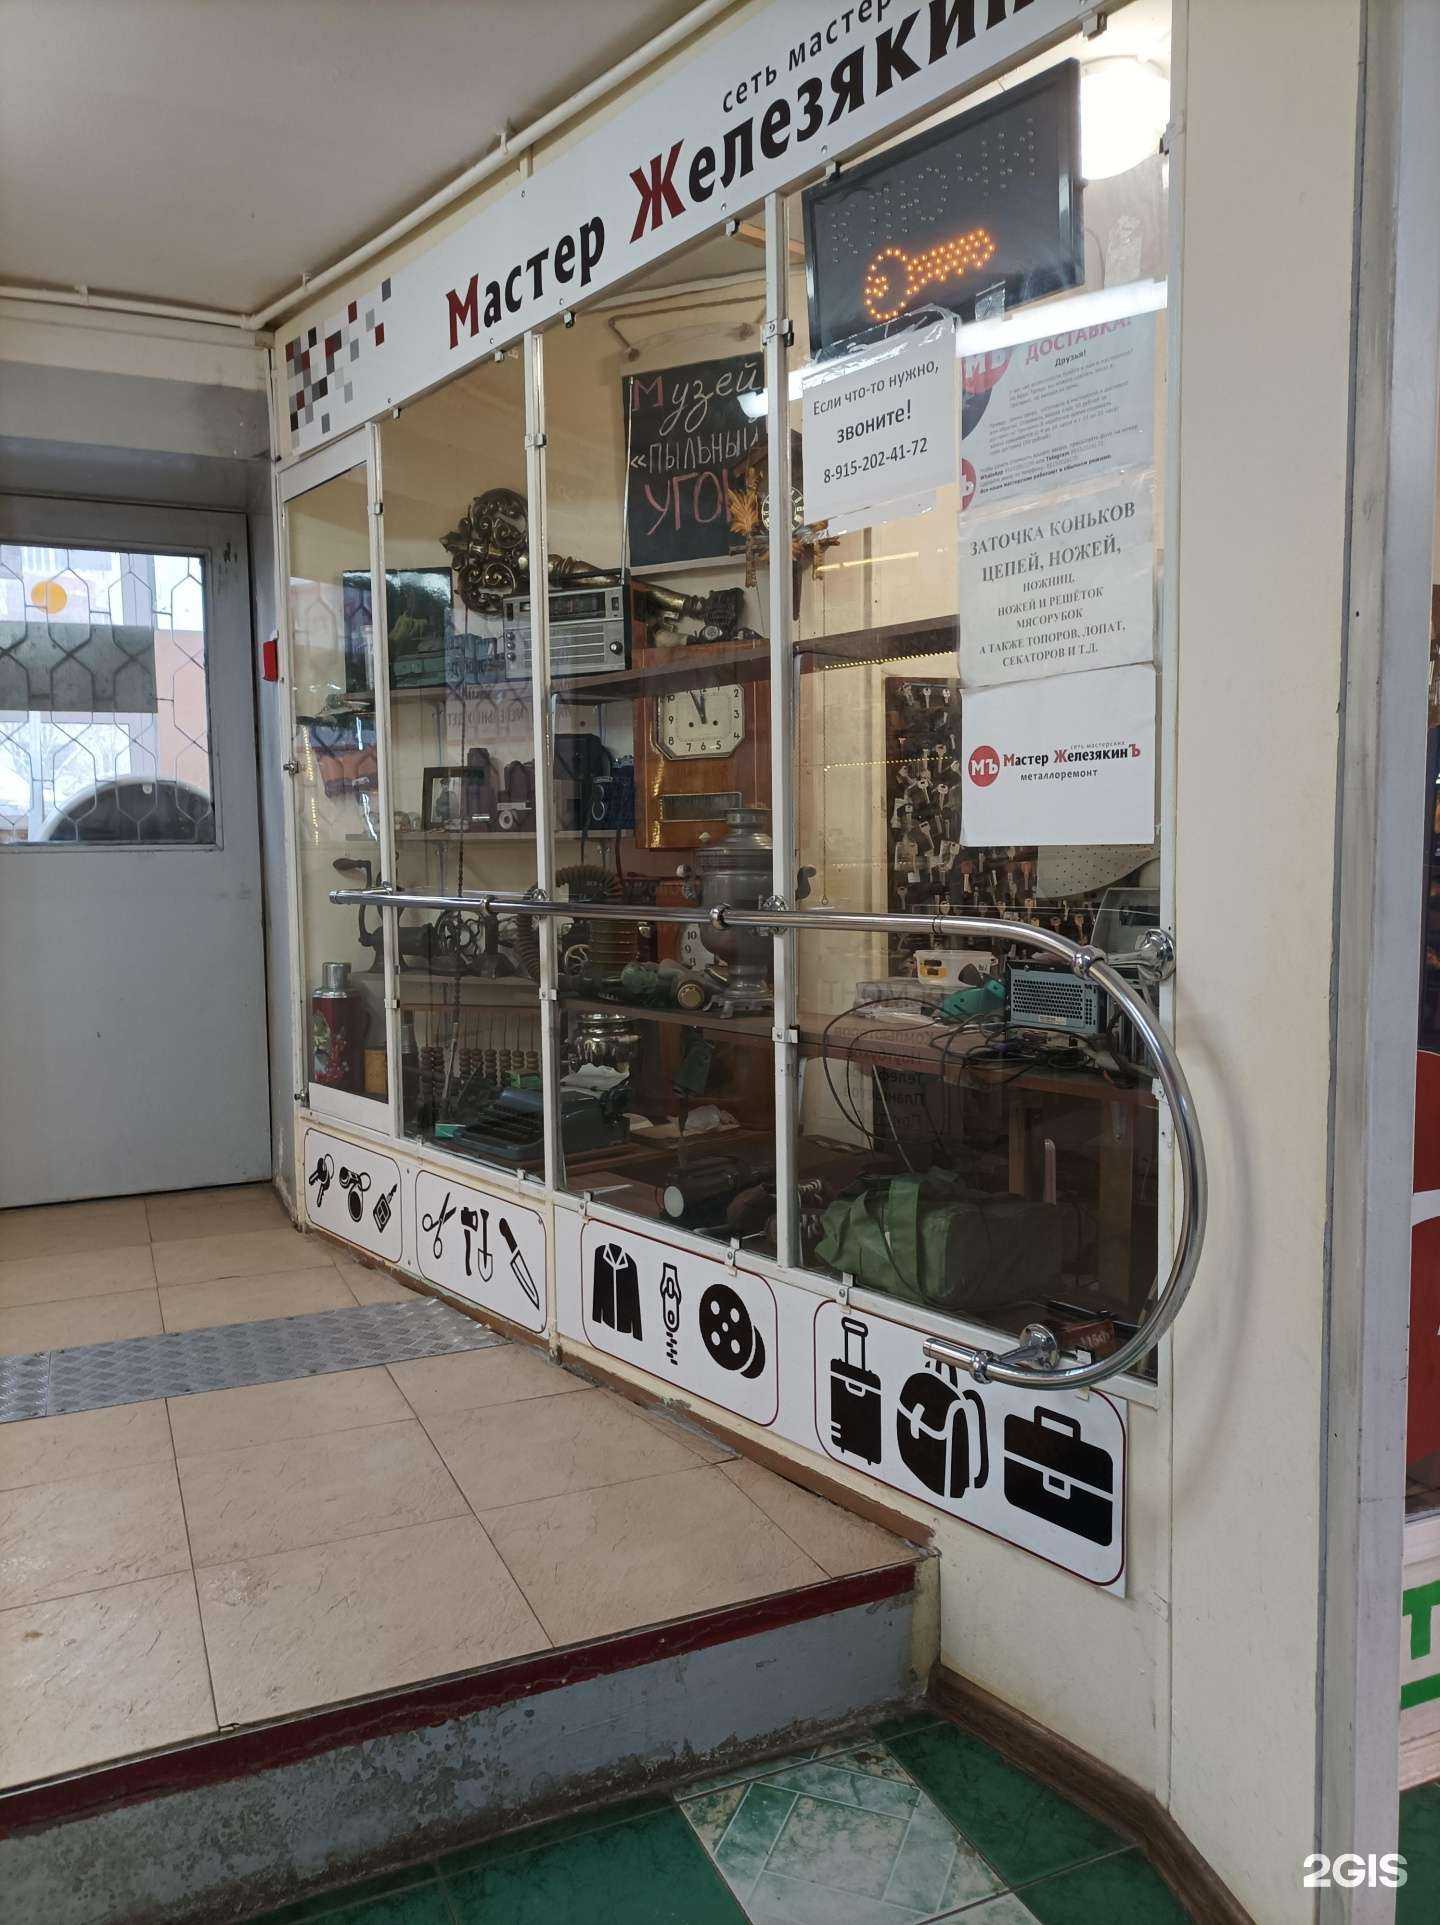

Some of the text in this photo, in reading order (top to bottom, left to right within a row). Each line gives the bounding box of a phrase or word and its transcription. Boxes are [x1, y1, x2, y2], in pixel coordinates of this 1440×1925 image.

[722, 67, 778, 114] сеть
[445, 216, 605, 350] Мастер
[813, 360, 940, 416] Если что-то нужно,
[631, 362, 762, 436] Музей
[836, 399, 912, 444] звоните!
[823, 437, 928, 484] 8-915-202-41-72
[969, 502, 1136, 556] ЗАТОЧКА КОНЬКОВ
[982, 533, 1122, 582] ЦЕПЕЙ, НОЖЕЙ,
[998, 598, 1036, 617] НОЖЕЙ
[1039, 597, 1047, 607] И
[1016, 608, 1084, 629] МЯСОРУБОК
[988, 638, 1024, 654] ТАКЖЕ
[1002, 647, 1065, 668] СЕКАТОРОВ
[1068, 647, 1077, 658] И
[733, 689, 739, 697] 2
[668, 716, 674, 724] 9
[733, 709, 740, 719] 3
[668, 737, 674, 745] 8
[733, 731, 741, 740] 4
[686, 742, 692, 752] 7
[700, 742, 707, 751] 6
[716, 740, 722, 750] 5
[1086, 740, 1126, 749] мастерских
[1003, 743, 1141, 767] Мастер ЖелезякинЪ
[971, 758, 999, 777] МЪ
[1020, 768, 1098, 782] металлоремонт
[687, 930, 697, 940] 10
[685, 945, 691, 953] 9
